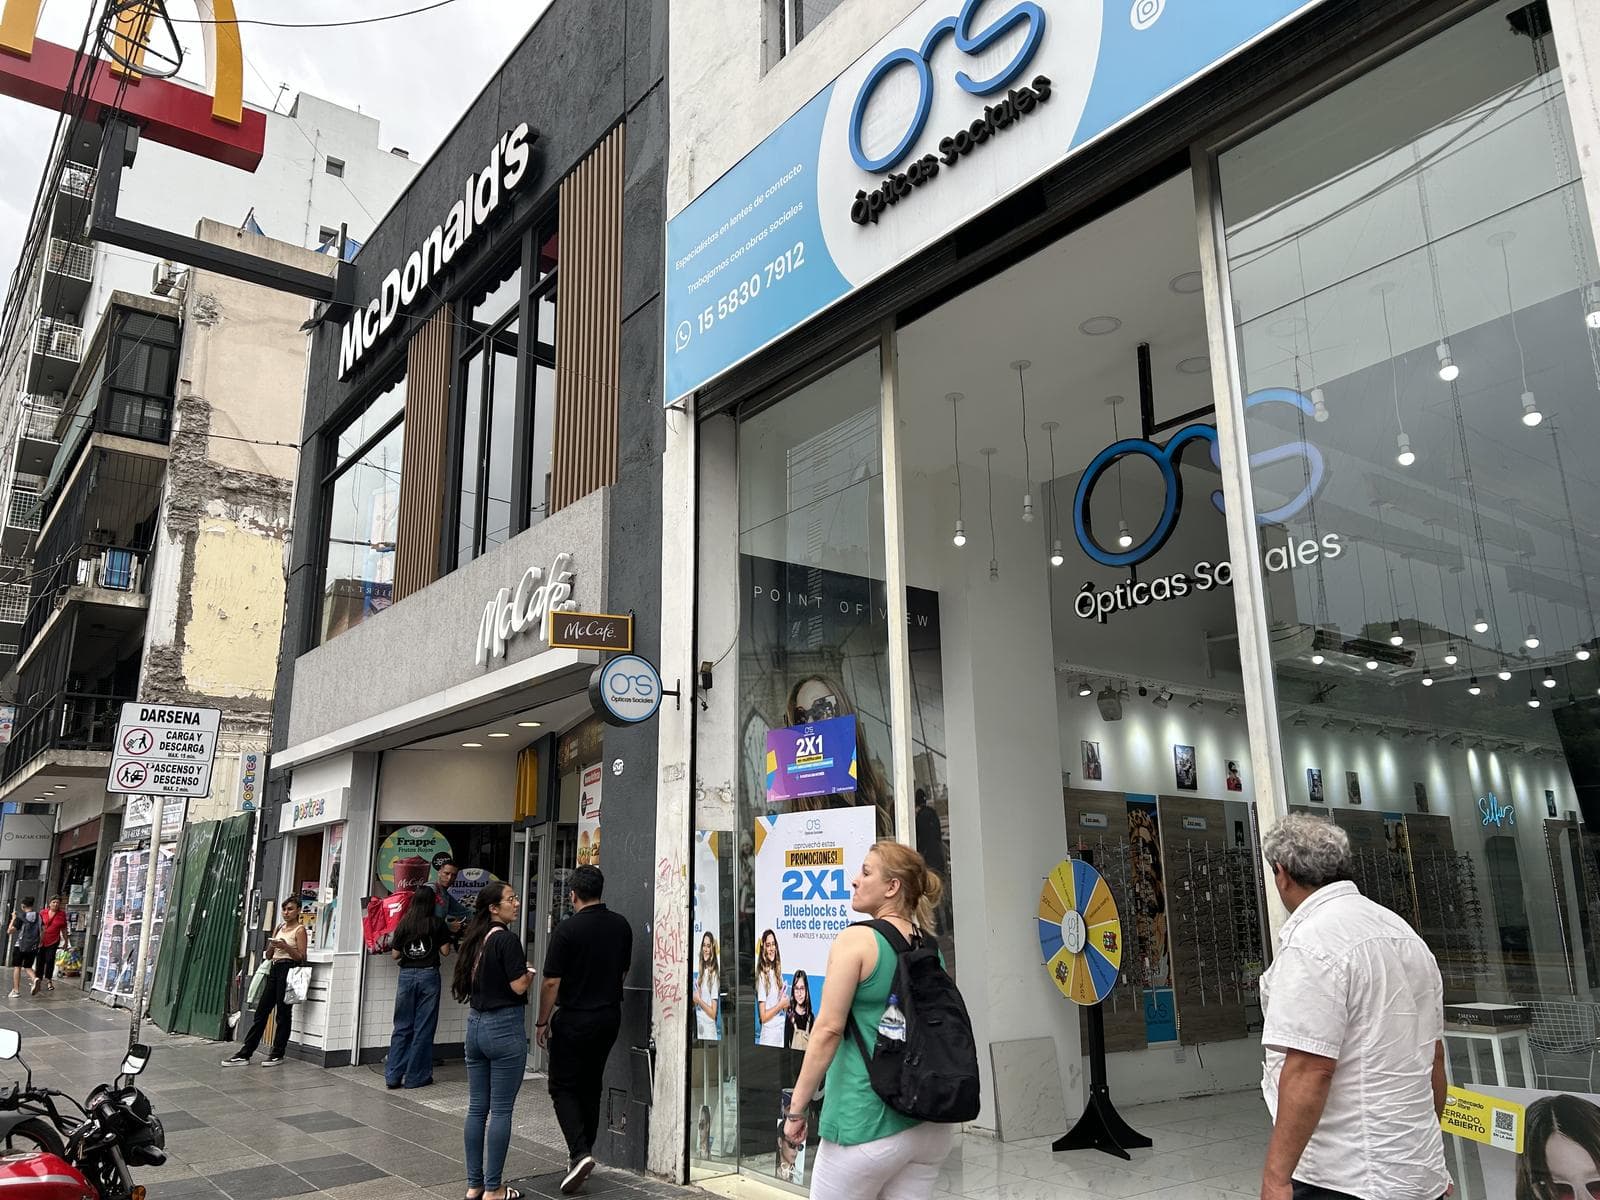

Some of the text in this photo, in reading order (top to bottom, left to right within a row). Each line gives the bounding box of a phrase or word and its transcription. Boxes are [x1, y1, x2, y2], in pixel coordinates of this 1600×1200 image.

[851, 153, 939, 225] Ópticas
[675, 163, 803, 271] Especialistas en lentes de contacto
[338, 122, 532, 382] McDonald's
[687, 201, 804, 296] Trabajamos con obras sociales
[698, 240, 805, 335] 15 5830 7912
[1074, 532, 1341, 623] Ópticas Soales
[475, 552, 577, 665] McCafé
[754, 585, 928, 627] POINT OF VEW
[563, 620, 617, 642] McCafé
[611, 695, 631, 703] Ópticas
[140, 708, 201, 726] DARSENA
[166, 731, 203, 742] CARGA Y
[796, 734, 823, 757] 2X1
[160, 741, 205, 755] DESCARGA
[153, 763, 203, 775] ASCENSO Y
[153, 775, 199, 786] DESCENSO
[242, 754, 257, 811] postres
[293, 798, 325, 827] postres
[397, 837, 437, 848] Frappé
[790, 850, 838, 866] PROMOCIONES!
[782, 869, 851, 901] 2X1
[784, 904, 848, 917] Blueblocks &
[776, 917, 807, 930] Lentes
[808, 917, 821, 930] de
[1457, 1098, 1484, 1110] mercado
[1447, 1117, 1486, 1134] ABIERTO
